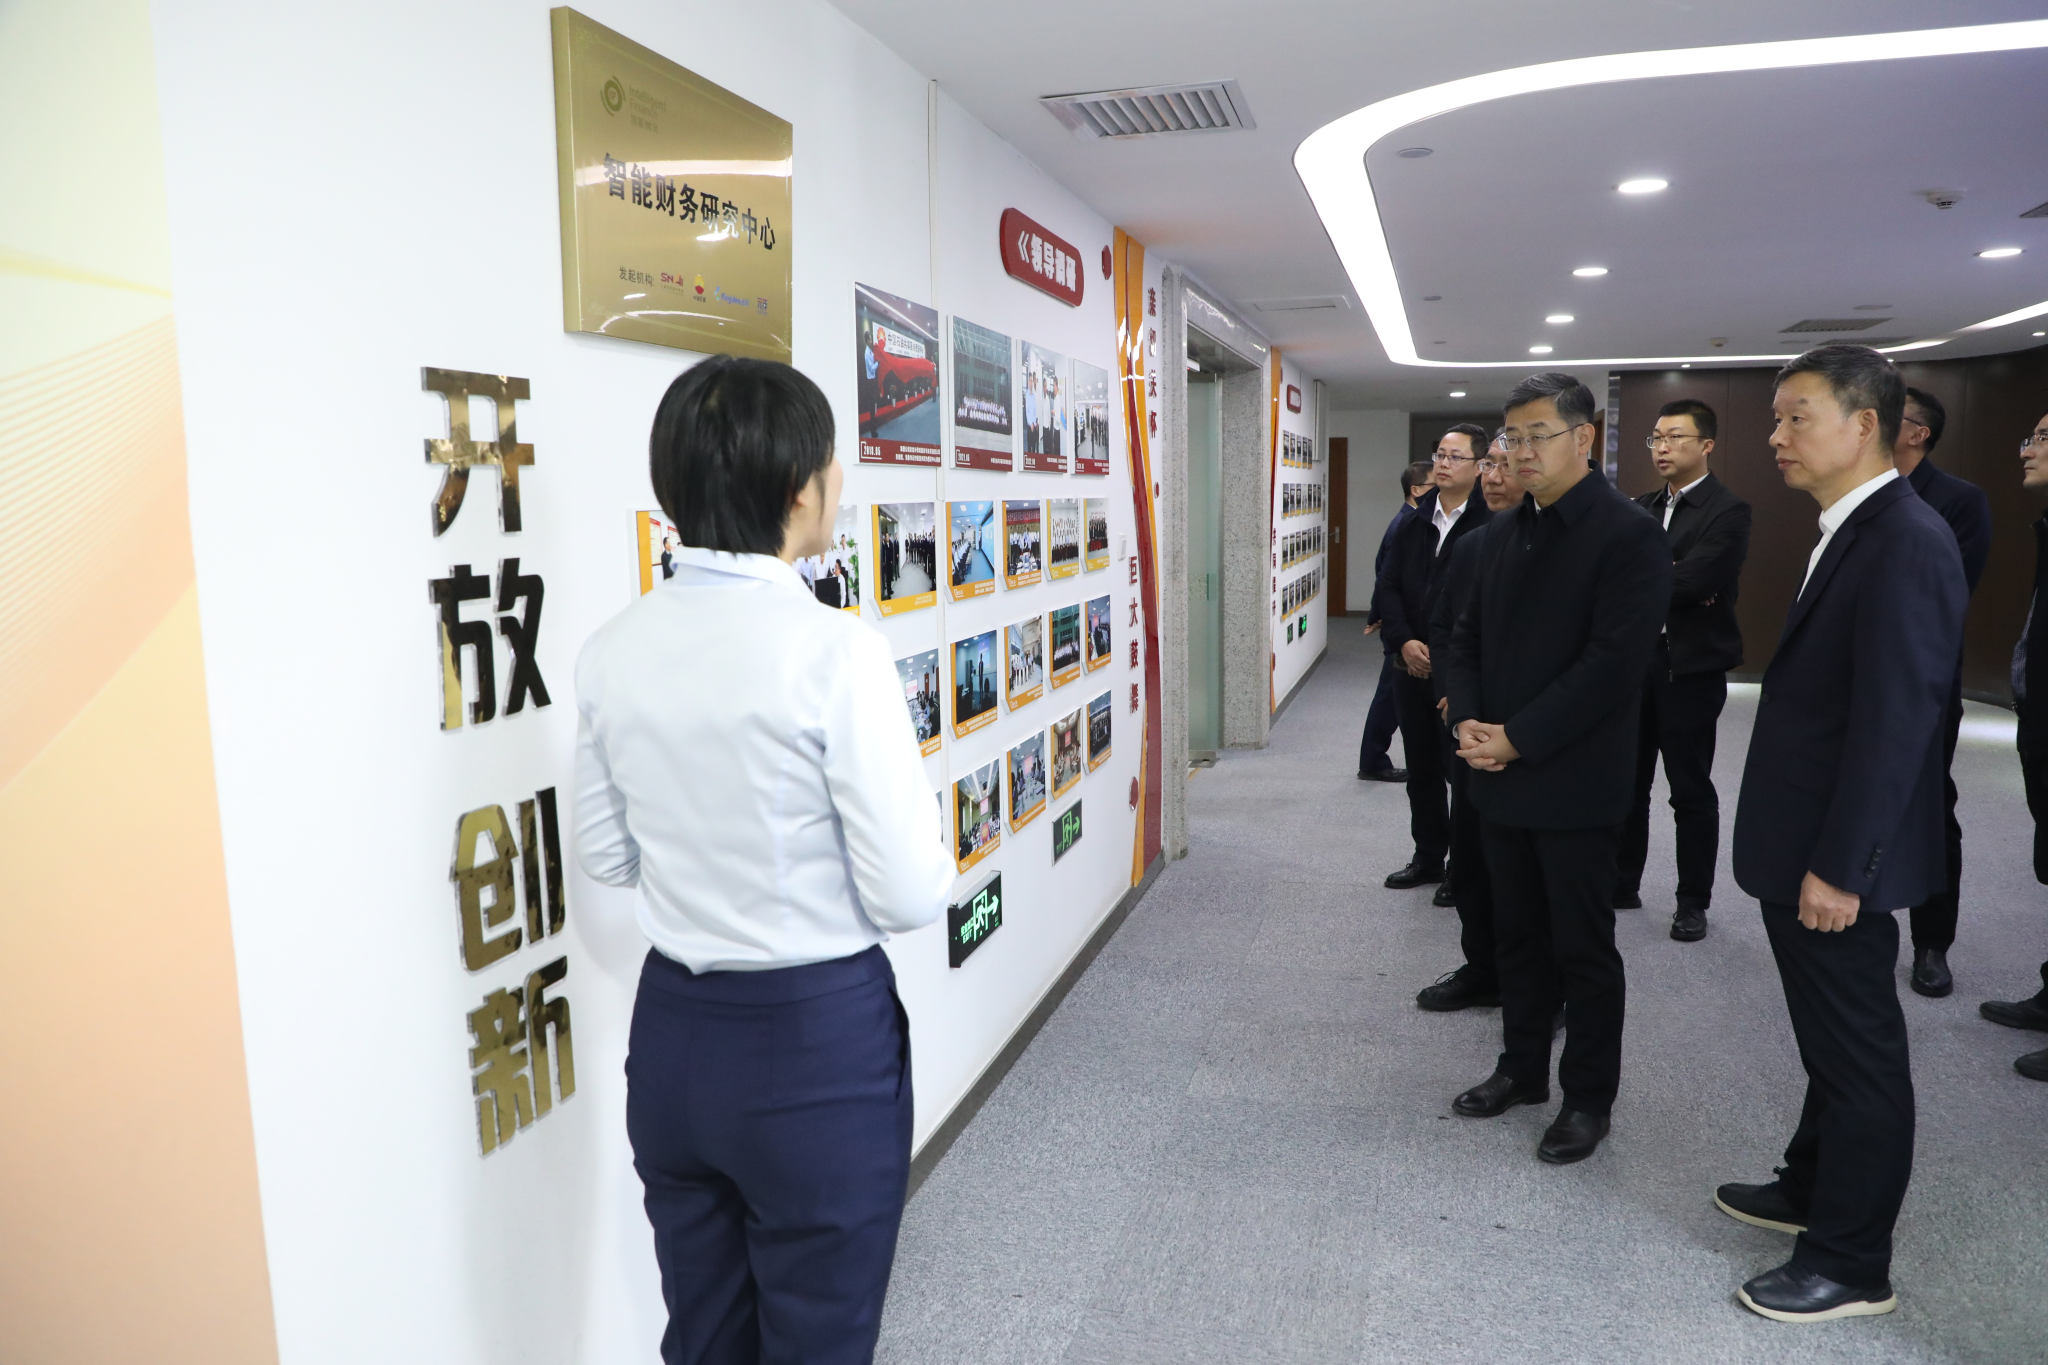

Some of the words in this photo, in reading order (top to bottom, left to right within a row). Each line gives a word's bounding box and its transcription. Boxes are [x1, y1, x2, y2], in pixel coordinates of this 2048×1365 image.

[629, 85, 667, 113] Intelligent
[603, 152, 776, 251] 智能财务研究中心
[1129, 556, 1139, 714] 巨大鼓舞
[420, 366, 577, 1159] 开放创新
[963, 929, 973, 944] EXIT
